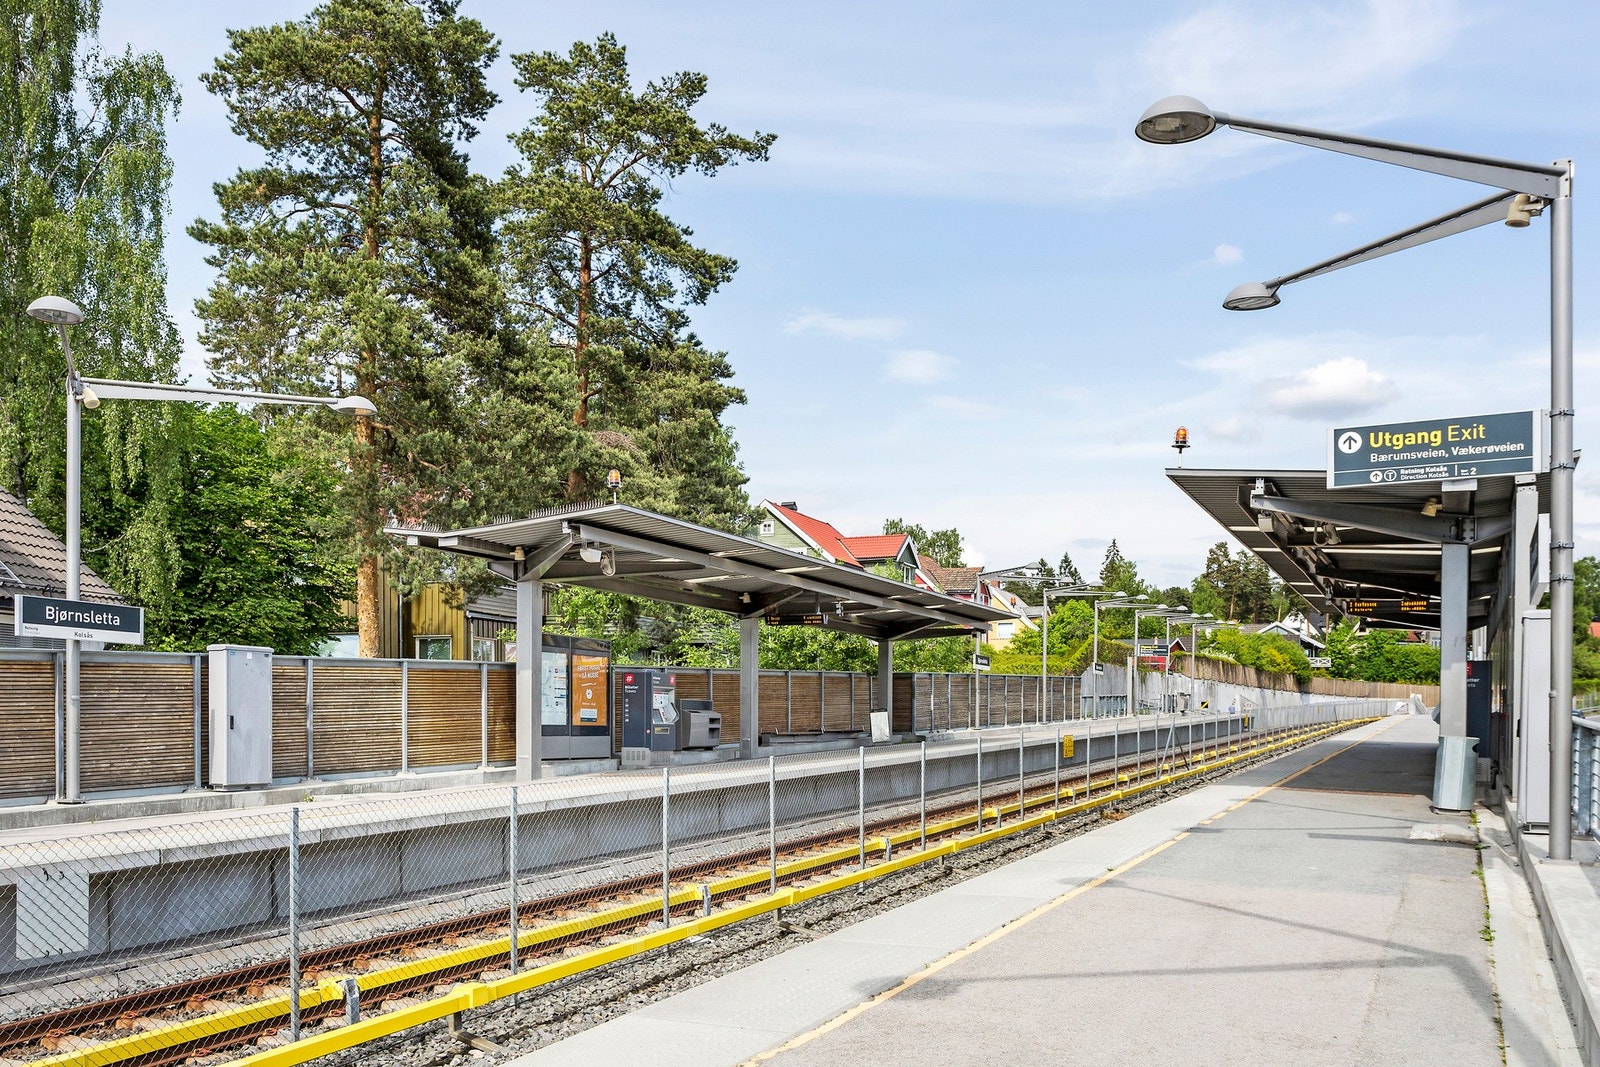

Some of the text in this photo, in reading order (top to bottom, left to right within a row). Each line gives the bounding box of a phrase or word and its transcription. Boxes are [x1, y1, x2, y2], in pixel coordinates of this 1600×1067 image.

[1369, 423, 1486, 450] Utgang Exit
[1370, 442, 1525, 463] Bærumsveien, Vækerøveien
[1470, 467, 1477, 475] 2
[45, 605, 120, 626] Bjørnsletta
[74, 631, 94, 639] Kolsås
